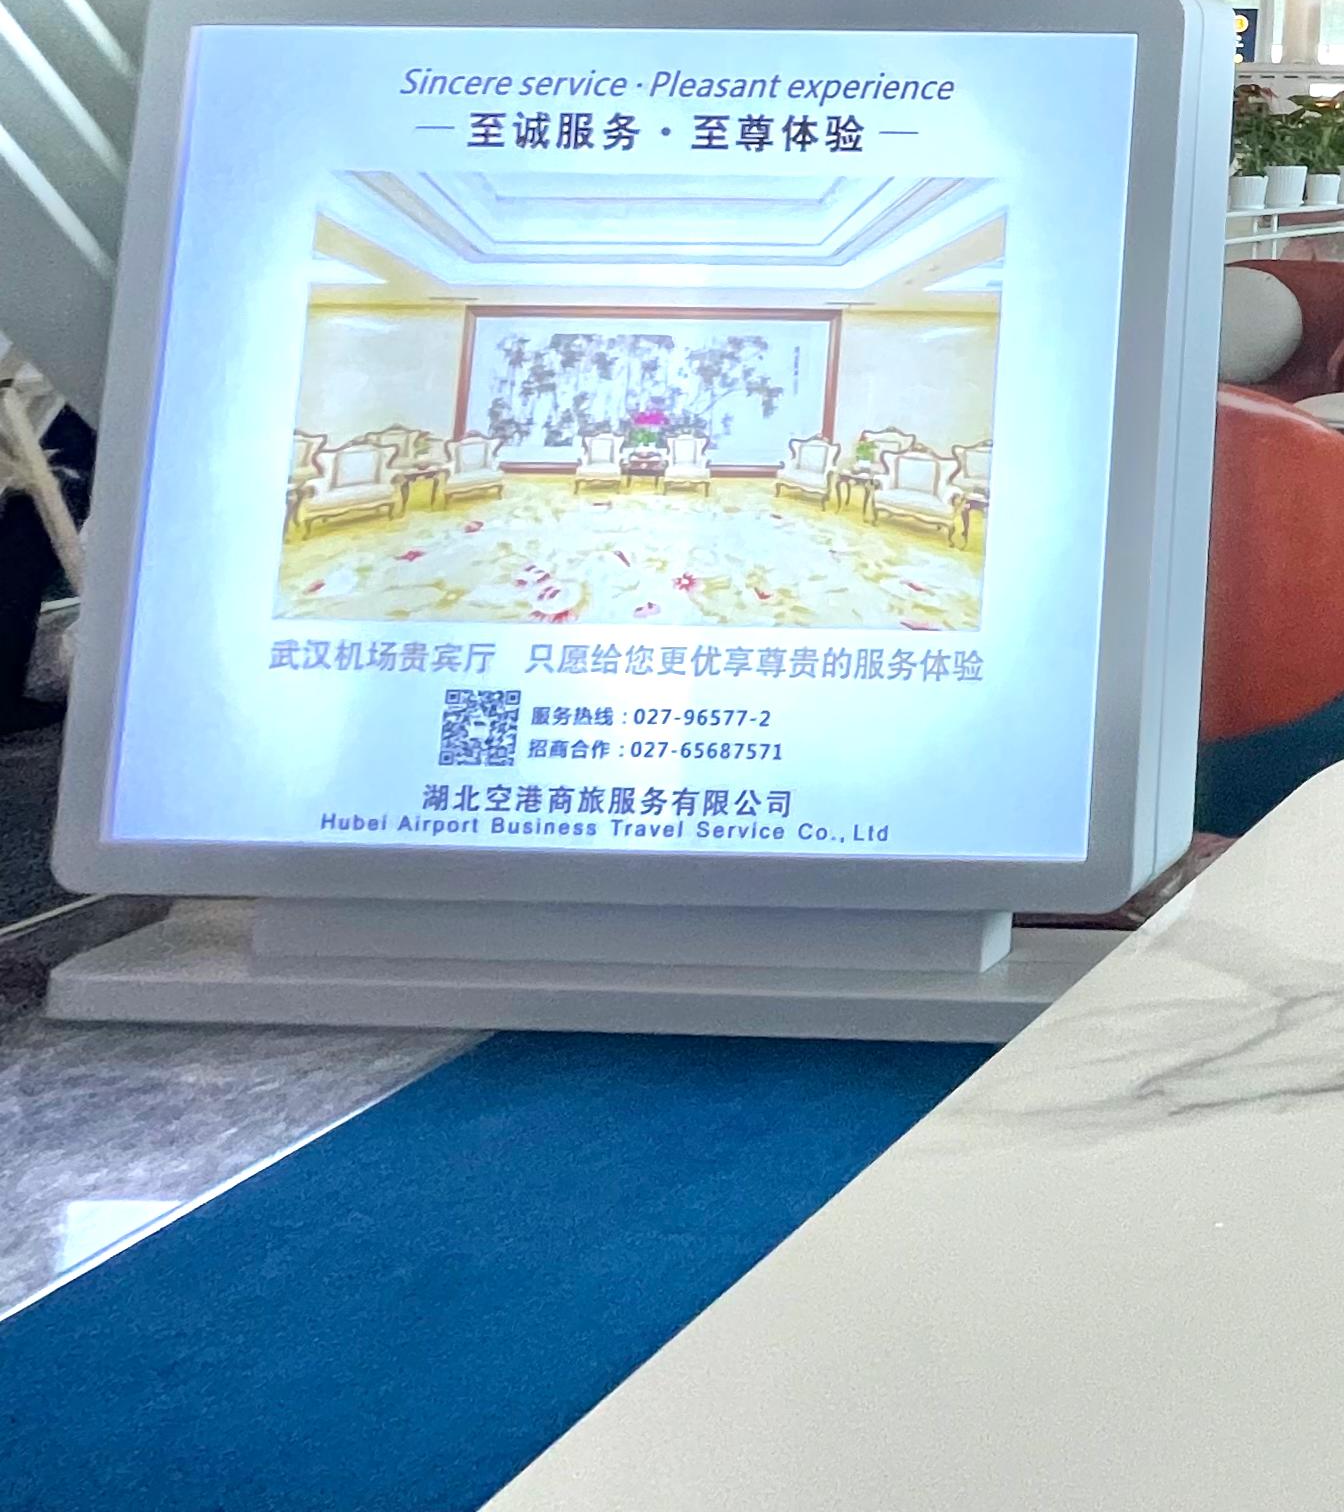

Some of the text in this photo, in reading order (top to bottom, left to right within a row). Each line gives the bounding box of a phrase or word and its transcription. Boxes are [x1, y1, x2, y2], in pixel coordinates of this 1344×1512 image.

[400, 68, 515, 96] Sincere
[518, 71, 628, 97] service
[649, 71, 781, 100] Pleasant
[786, 74, 956, 107] experience
[268, 638, 986, 683] 武汉机场贵宾厅 只愿给您更优享尊贵的服务体验
[421, 783, 793, 819] 湖北空港商旅服务有限公司
[320, 813, 388, 832] Hubei
[397, 815, 479, 837] Airport
[490, 817, 598, 837] Business
[610, 819, 684, 838] Travel
[695, 821, 786, 840] Service
